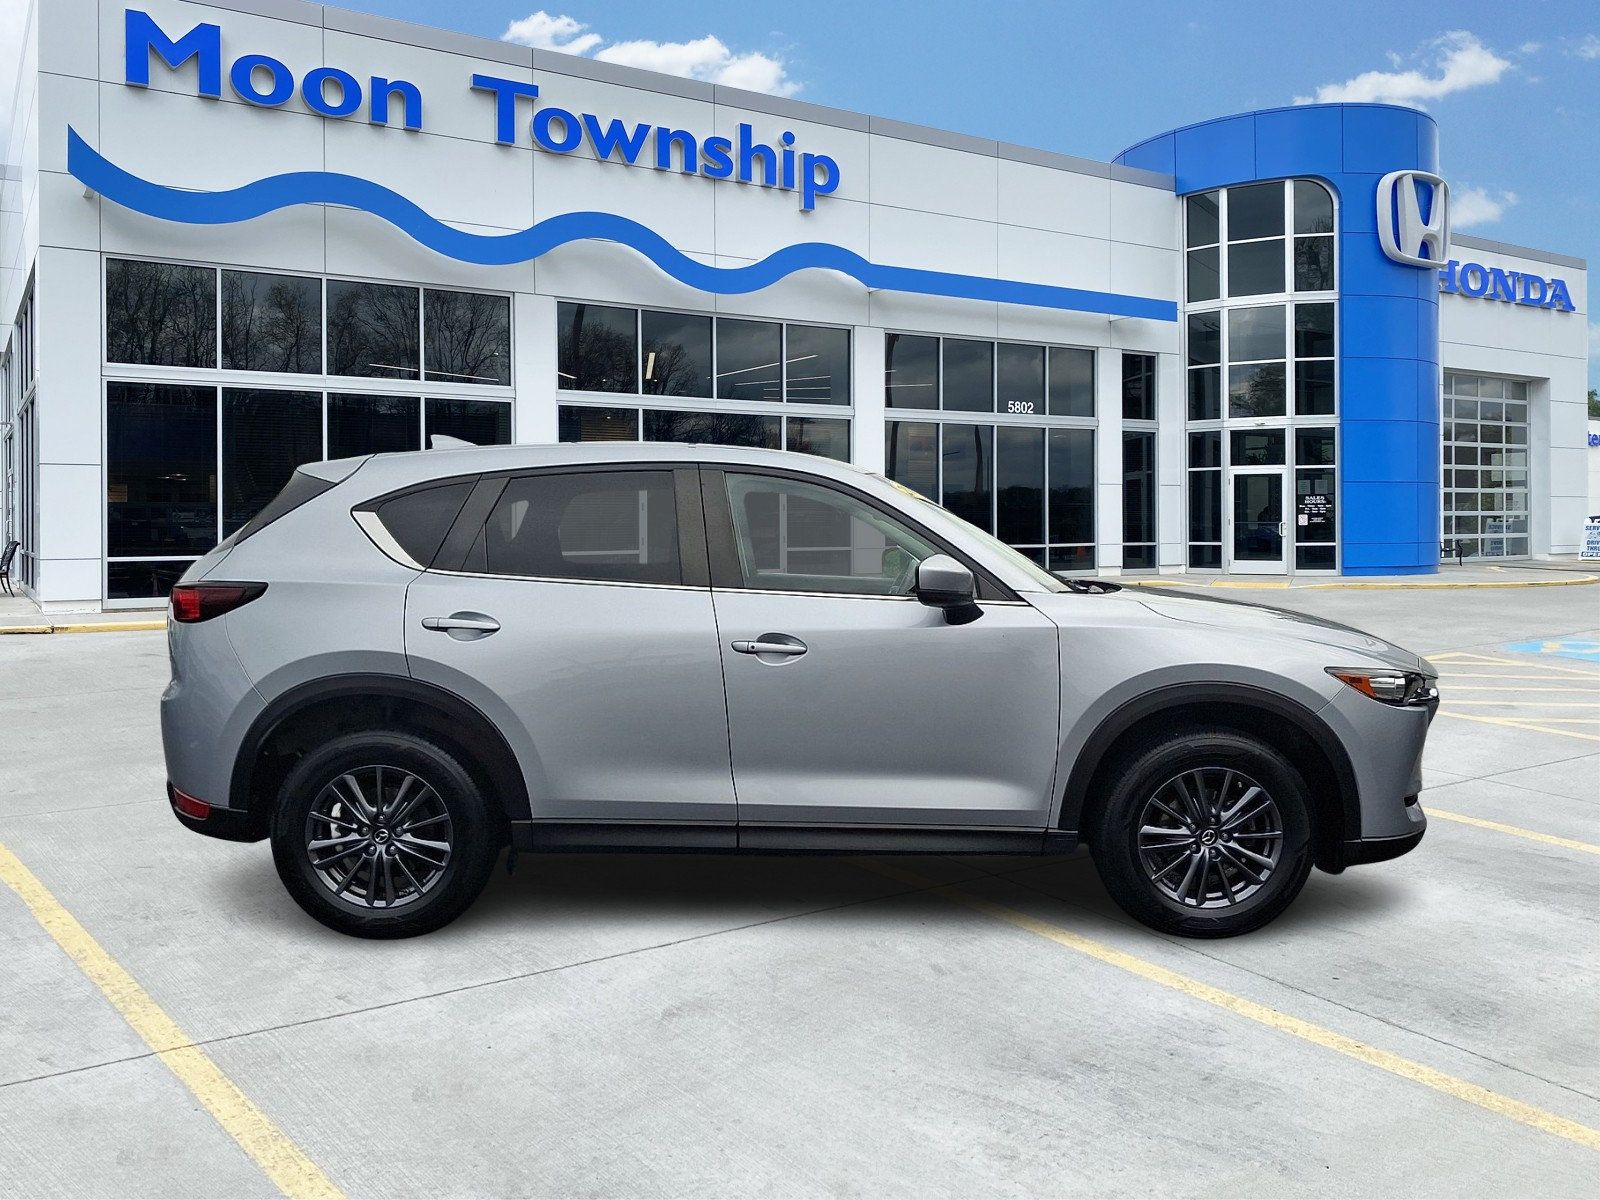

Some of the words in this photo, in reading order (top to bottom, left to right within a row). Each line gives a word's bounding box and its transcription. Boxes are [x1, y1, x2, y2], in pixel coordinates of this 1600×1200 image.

[125, 9, 422, 131] Moon
[470, 74, 840, 213] Township
[1007, 400, 1034, 414] 5802
